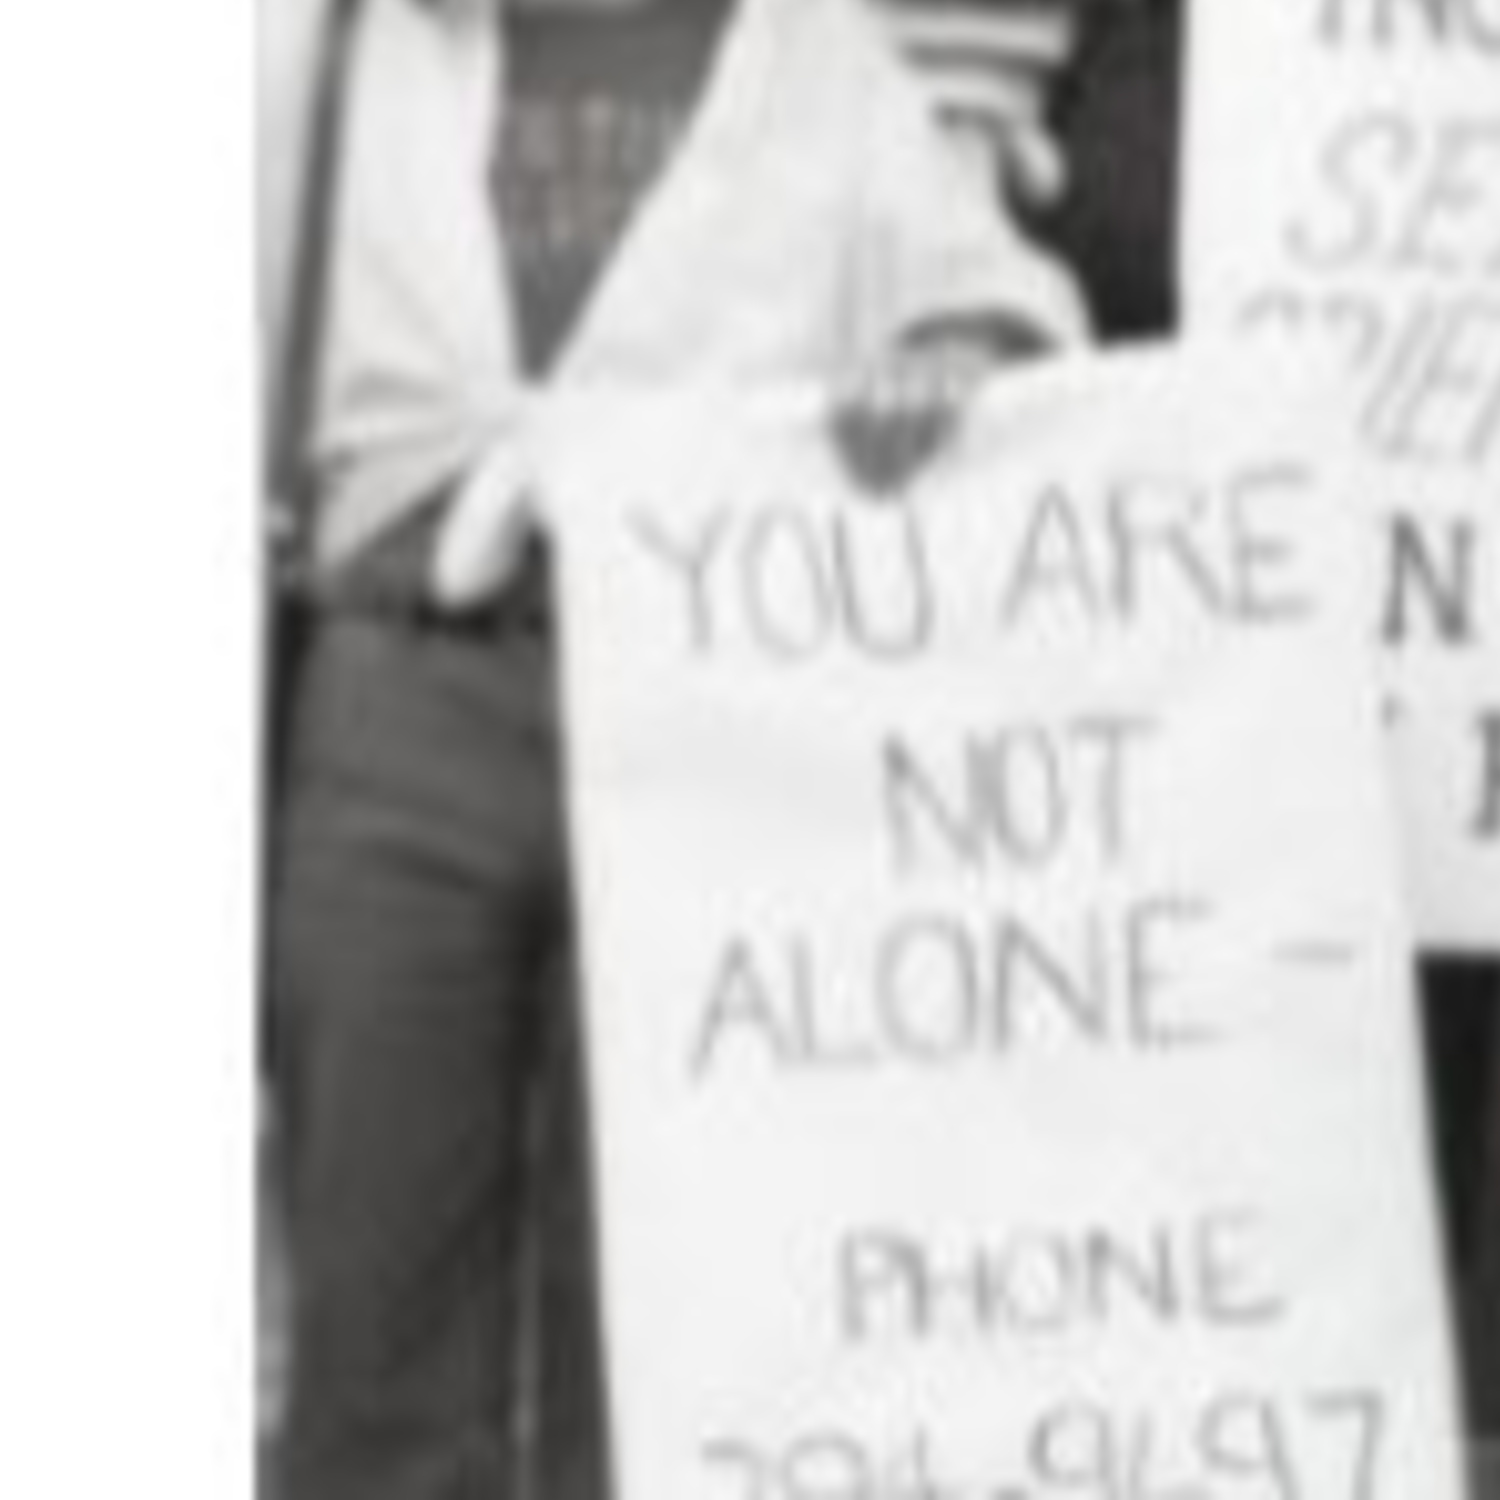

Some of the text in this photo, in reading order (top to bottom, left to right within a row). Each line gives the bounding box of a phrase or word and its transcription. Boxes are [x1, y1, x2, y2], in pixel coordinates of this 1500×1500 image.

[626, 462, 1314, 664] YOU ARE
[880, 712, 1156, 874] NOT
[690, 895, 1226, 1084] ALONE
[836, 1208, 1286, 1346] PHONE
